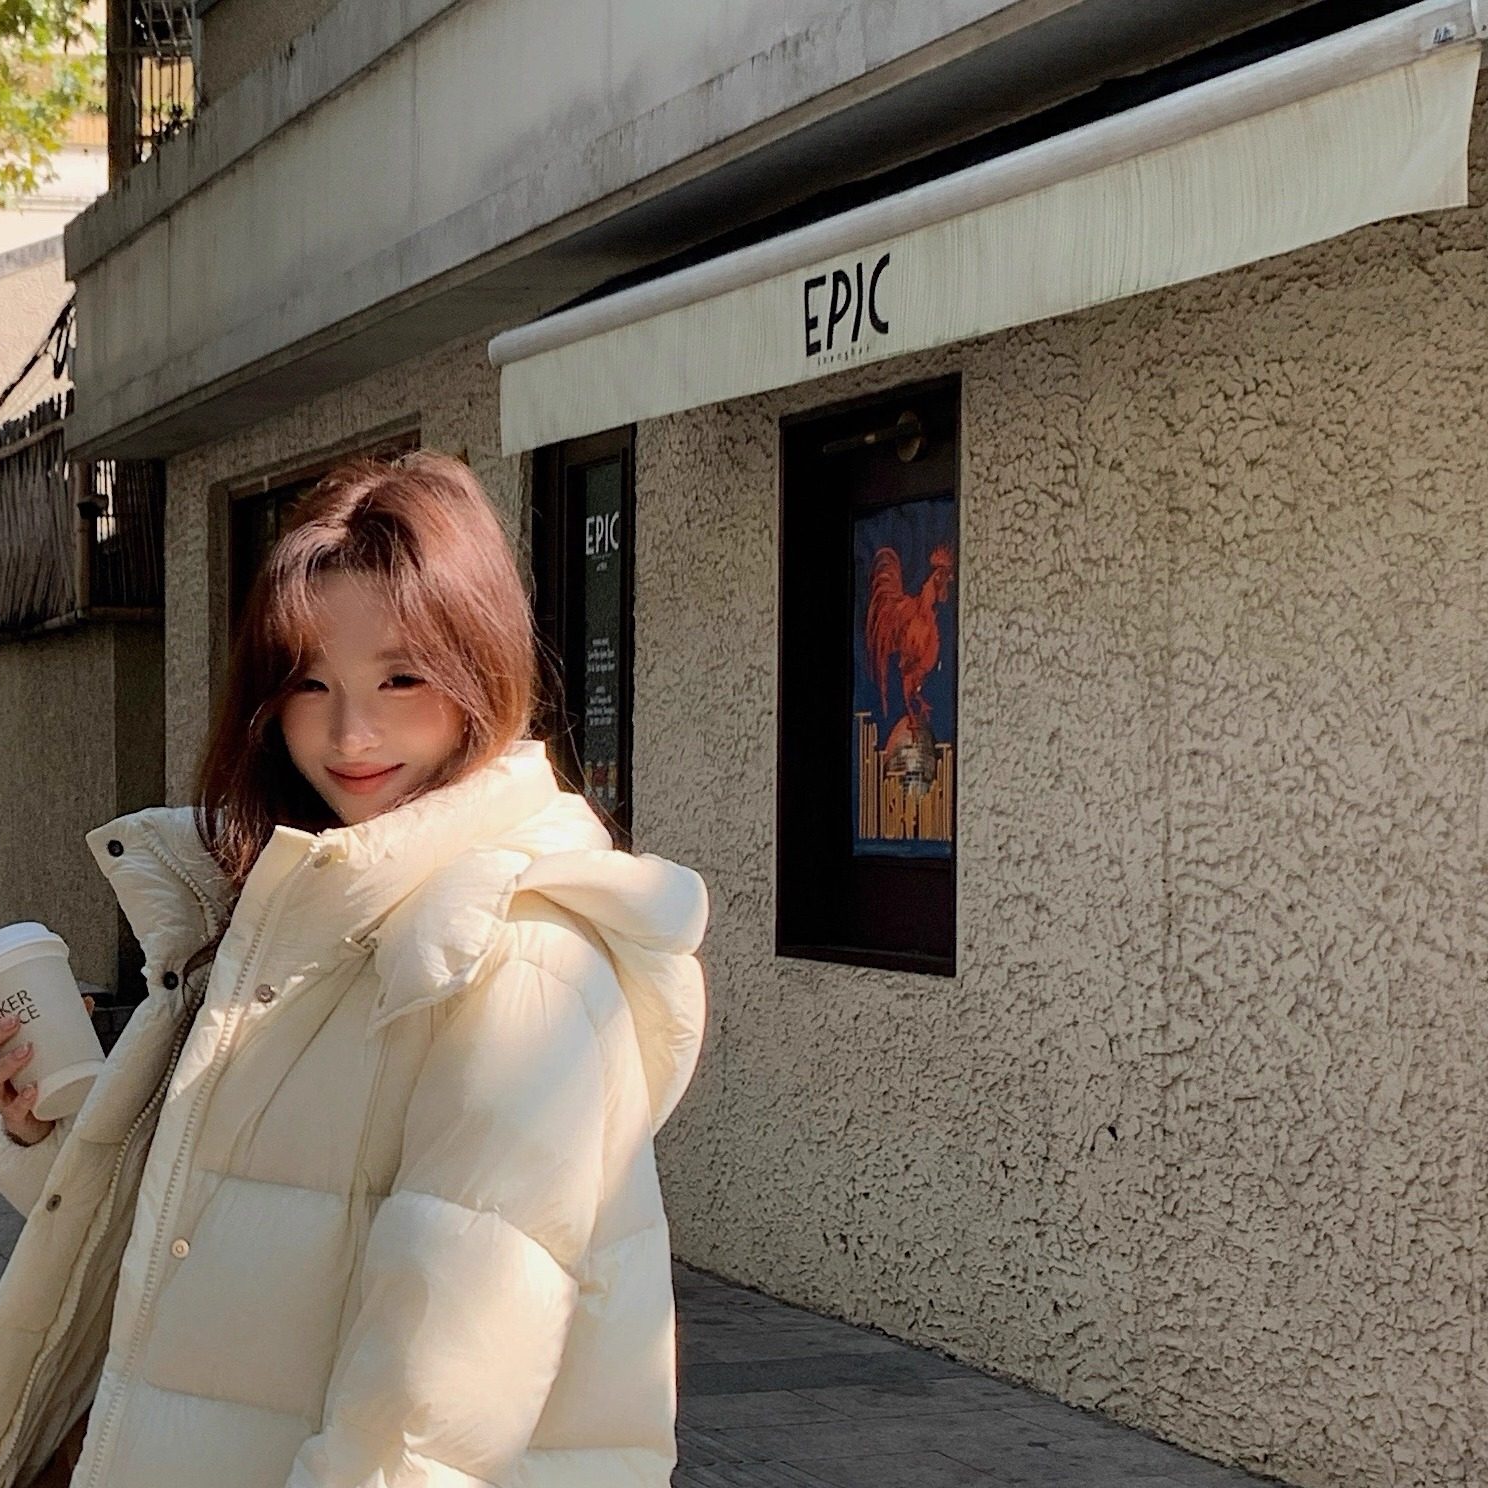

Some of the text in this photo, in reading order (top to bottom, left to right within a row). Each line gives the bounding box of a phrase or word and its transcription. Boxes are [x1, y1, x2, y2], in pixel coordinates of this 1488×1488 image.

[804, 252, 890, 357] EPIC
[585, 511, 620, 555] EPIC
[18, 1004, 41, 1024] CE
